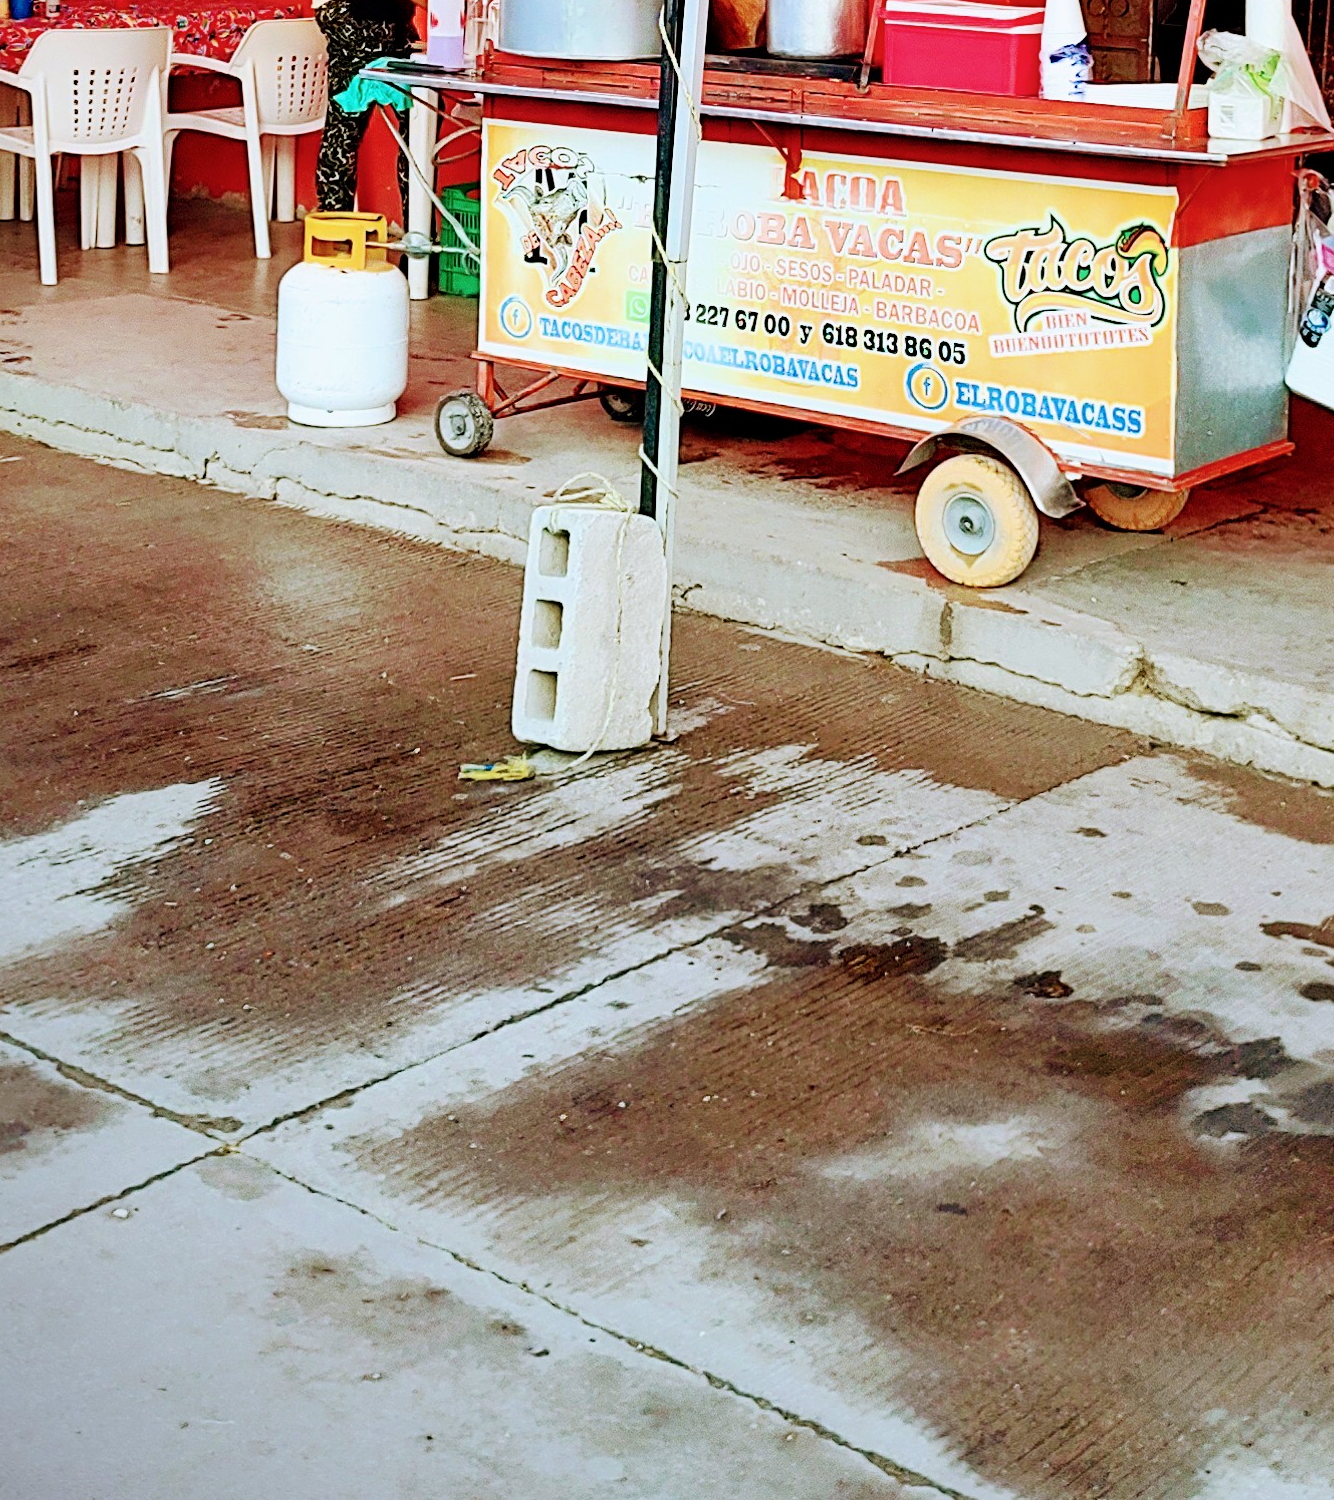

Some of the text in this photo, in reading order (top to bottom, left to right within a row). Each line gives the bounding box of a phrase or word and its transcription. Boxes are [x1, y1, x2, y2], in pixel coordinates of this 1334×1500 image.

[521, 232, 541, 254] DE
[730, 252, 932, 297] OJO SESOS PALADAR
[718, 277, 981, 333] LABIO MOLLEJA BARBACOA
[1045, 312, 1088, 330] BIEN
[695, 304, 730, 329] 227
[735, 309, 759, 332] 67
[764, 313, 790, 337] 00
[821, 322, 858, 350] 618
[863, 329, 898, 354] 313
[904, 335, 933, 360] 86
[938, 340, 966, 365] 05
[955, 381, 1143, 434] ELROBAVACASS
